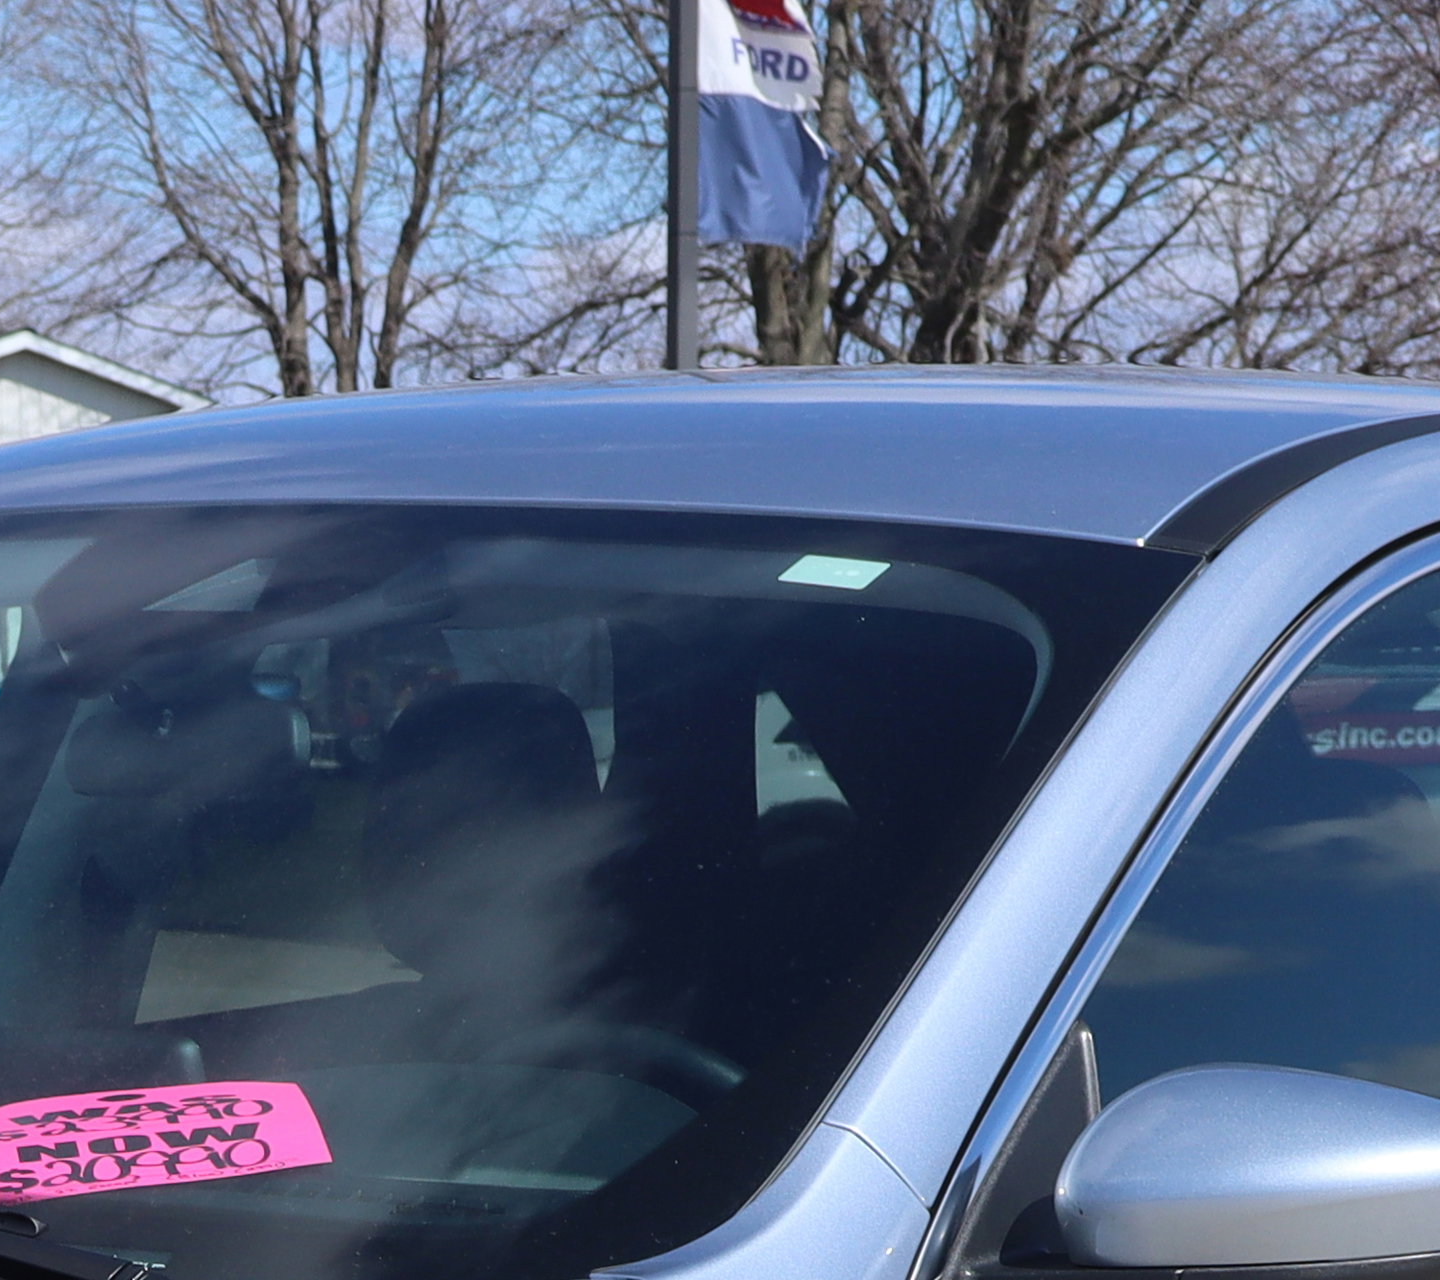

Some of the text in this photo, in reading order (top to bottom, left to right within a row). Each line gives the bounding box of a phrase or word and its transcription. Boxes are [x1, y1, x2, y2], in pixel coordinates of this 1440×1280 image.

[731, 38, 810, 83] FORD
[8, 1094, 242, 1126] WAS
[16, 1122, 260, 1163] NOW
